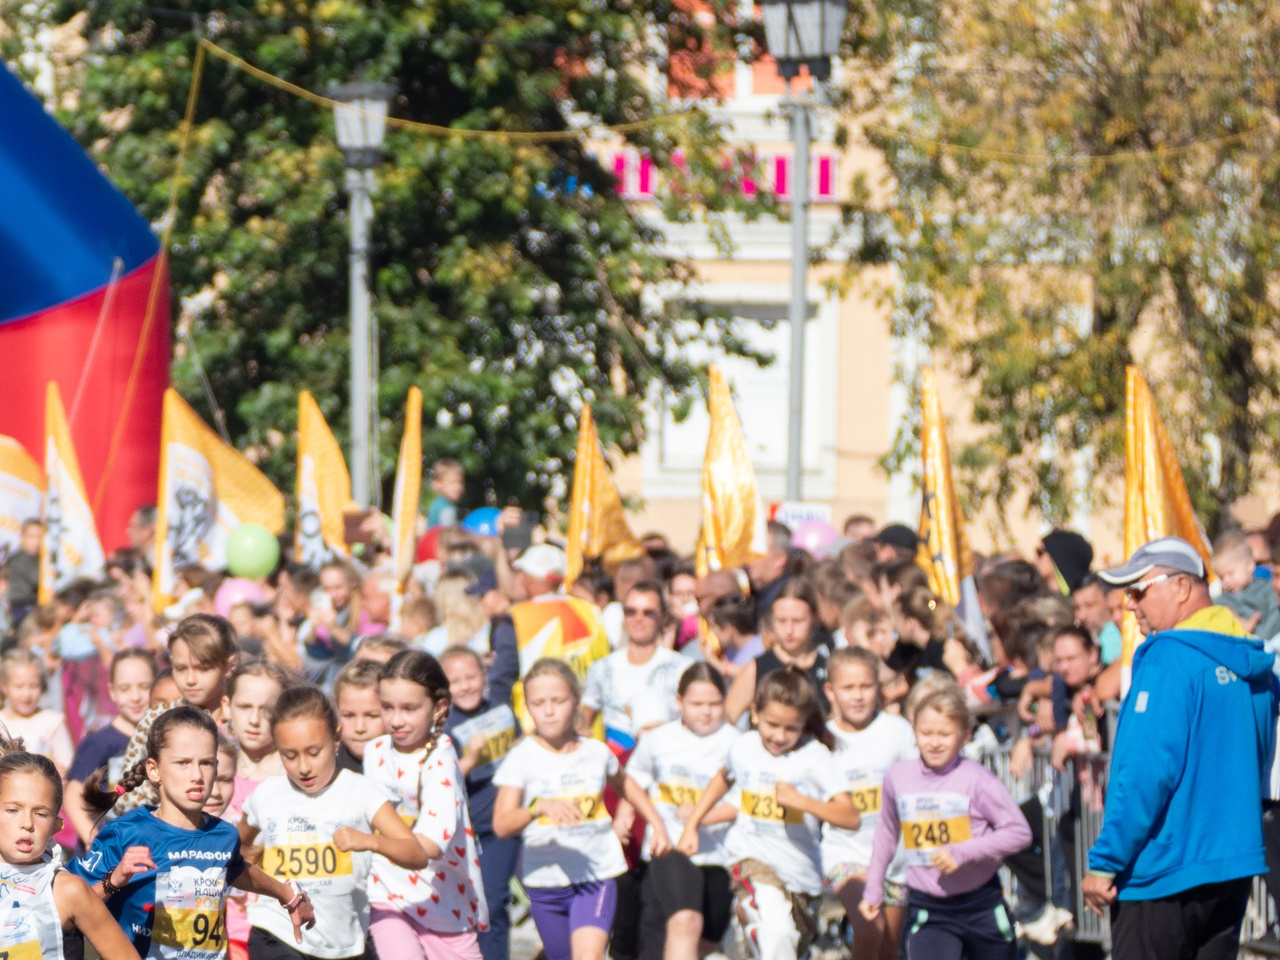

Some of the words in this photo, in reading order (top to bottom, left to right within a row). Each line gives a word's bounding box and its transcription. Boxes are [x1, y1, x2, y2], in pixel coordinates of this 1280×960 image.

[911, 821, 950, 847] 248
[167, 850, 231, 860] МАРАФОН
[274, 845, 337, 877] 2590
[192, 913, 222, 947] 94
